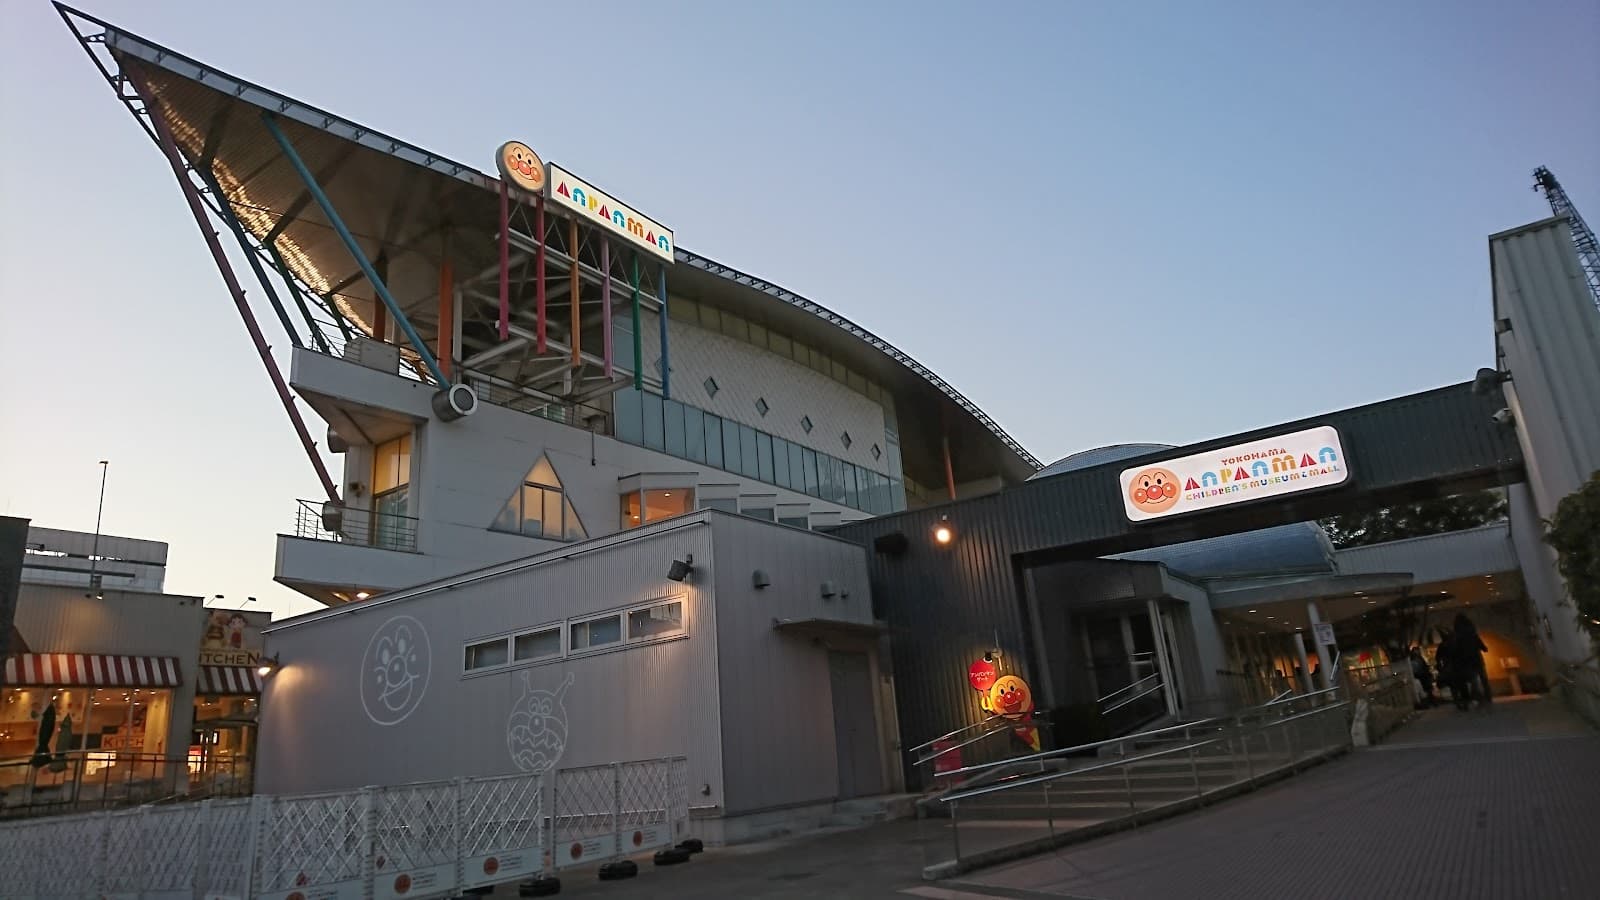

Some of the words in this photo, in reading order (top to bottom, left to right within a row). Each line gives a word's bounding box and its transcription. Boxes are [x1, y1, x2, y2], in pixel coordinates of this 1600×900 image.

[556, 181, 669, 252] ANPANMAN
[1184, 447, 1337, 491] ANPANMAN
[1221, 448, 1287, 465] YOKOHAMA
[1186, 483, 1248, 501] CHILDREN'S
[1250, 475, 1300, 488] MUSEUM
[1309, 465, 1340, 477] MALL
